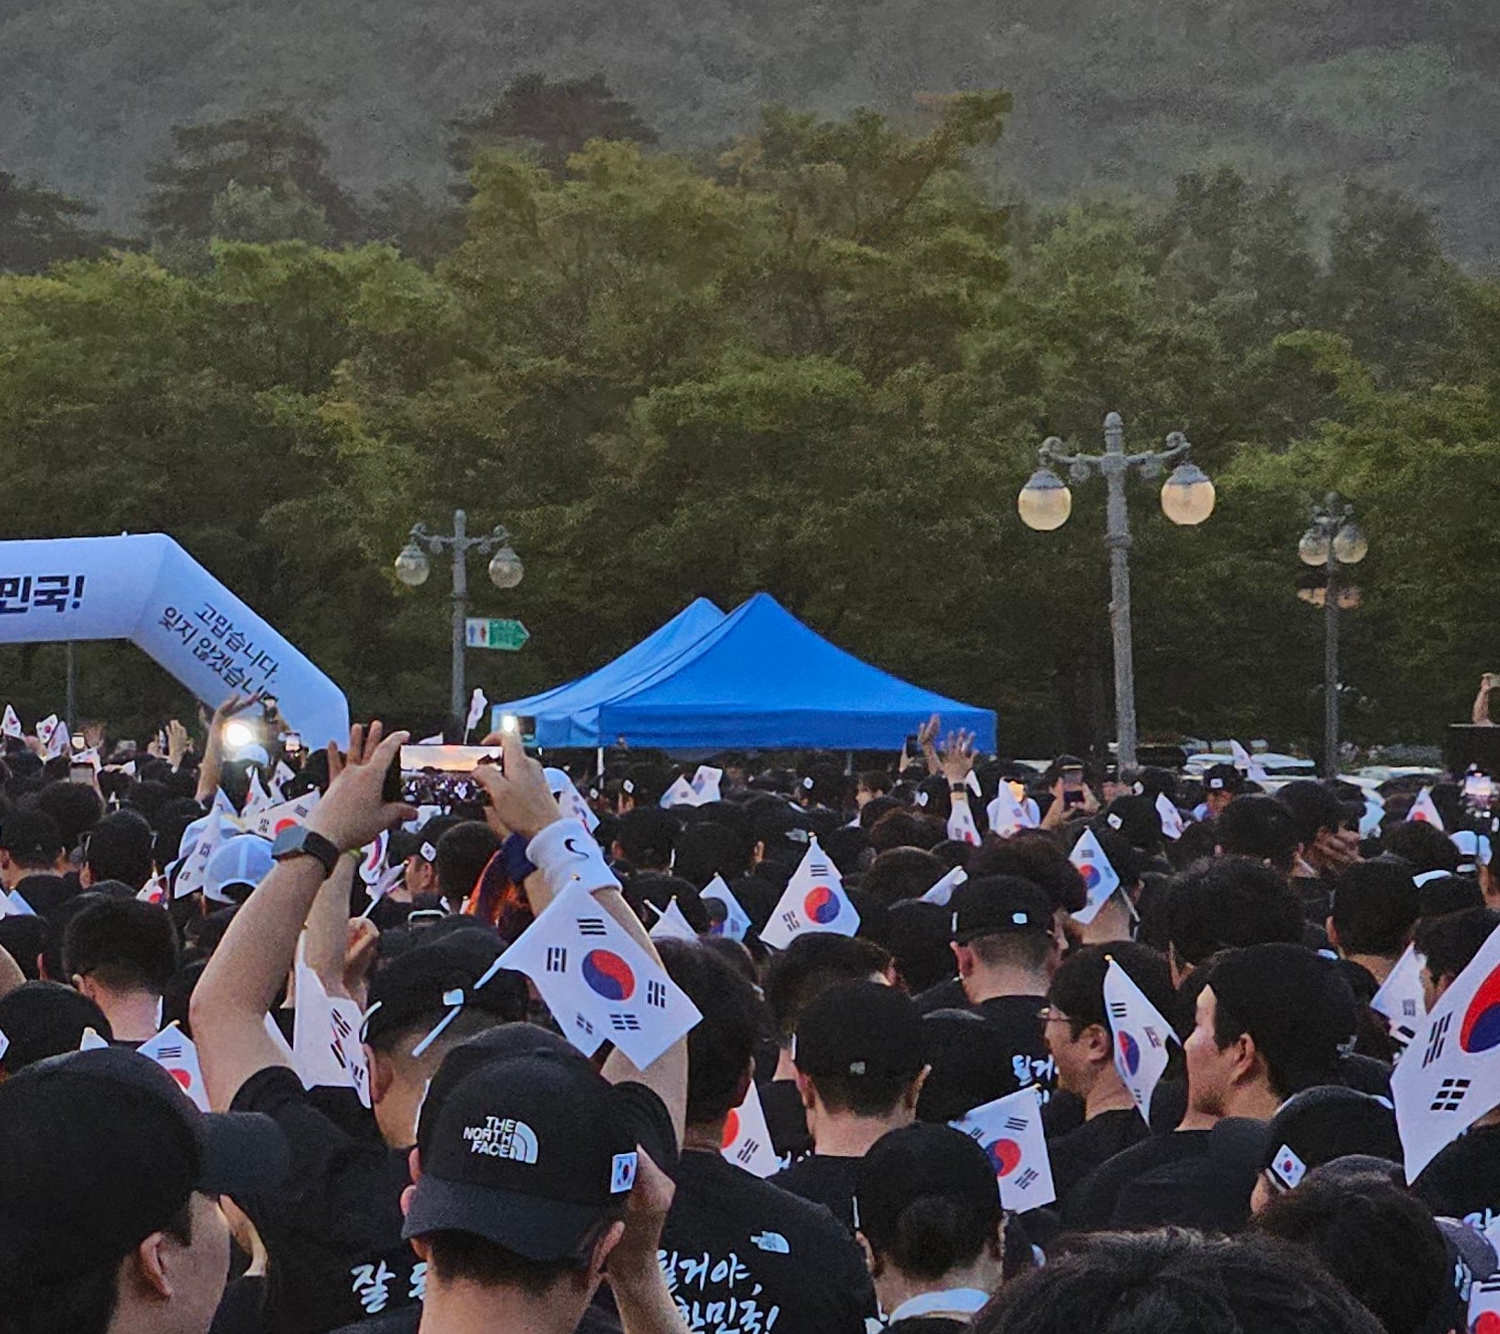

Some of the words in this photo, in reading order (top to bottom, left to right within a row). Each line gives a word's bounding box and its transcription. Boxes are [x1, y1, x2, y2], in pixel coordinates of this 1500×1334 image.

[158, 606, 199, 646] 잊지
[485, 1116, 516, 1133] THE
[463, 1126, 512, 1145] NORTH
[471, 1140, 510, 1158] FACE
[350, 1259, 397, 1314] 잘
